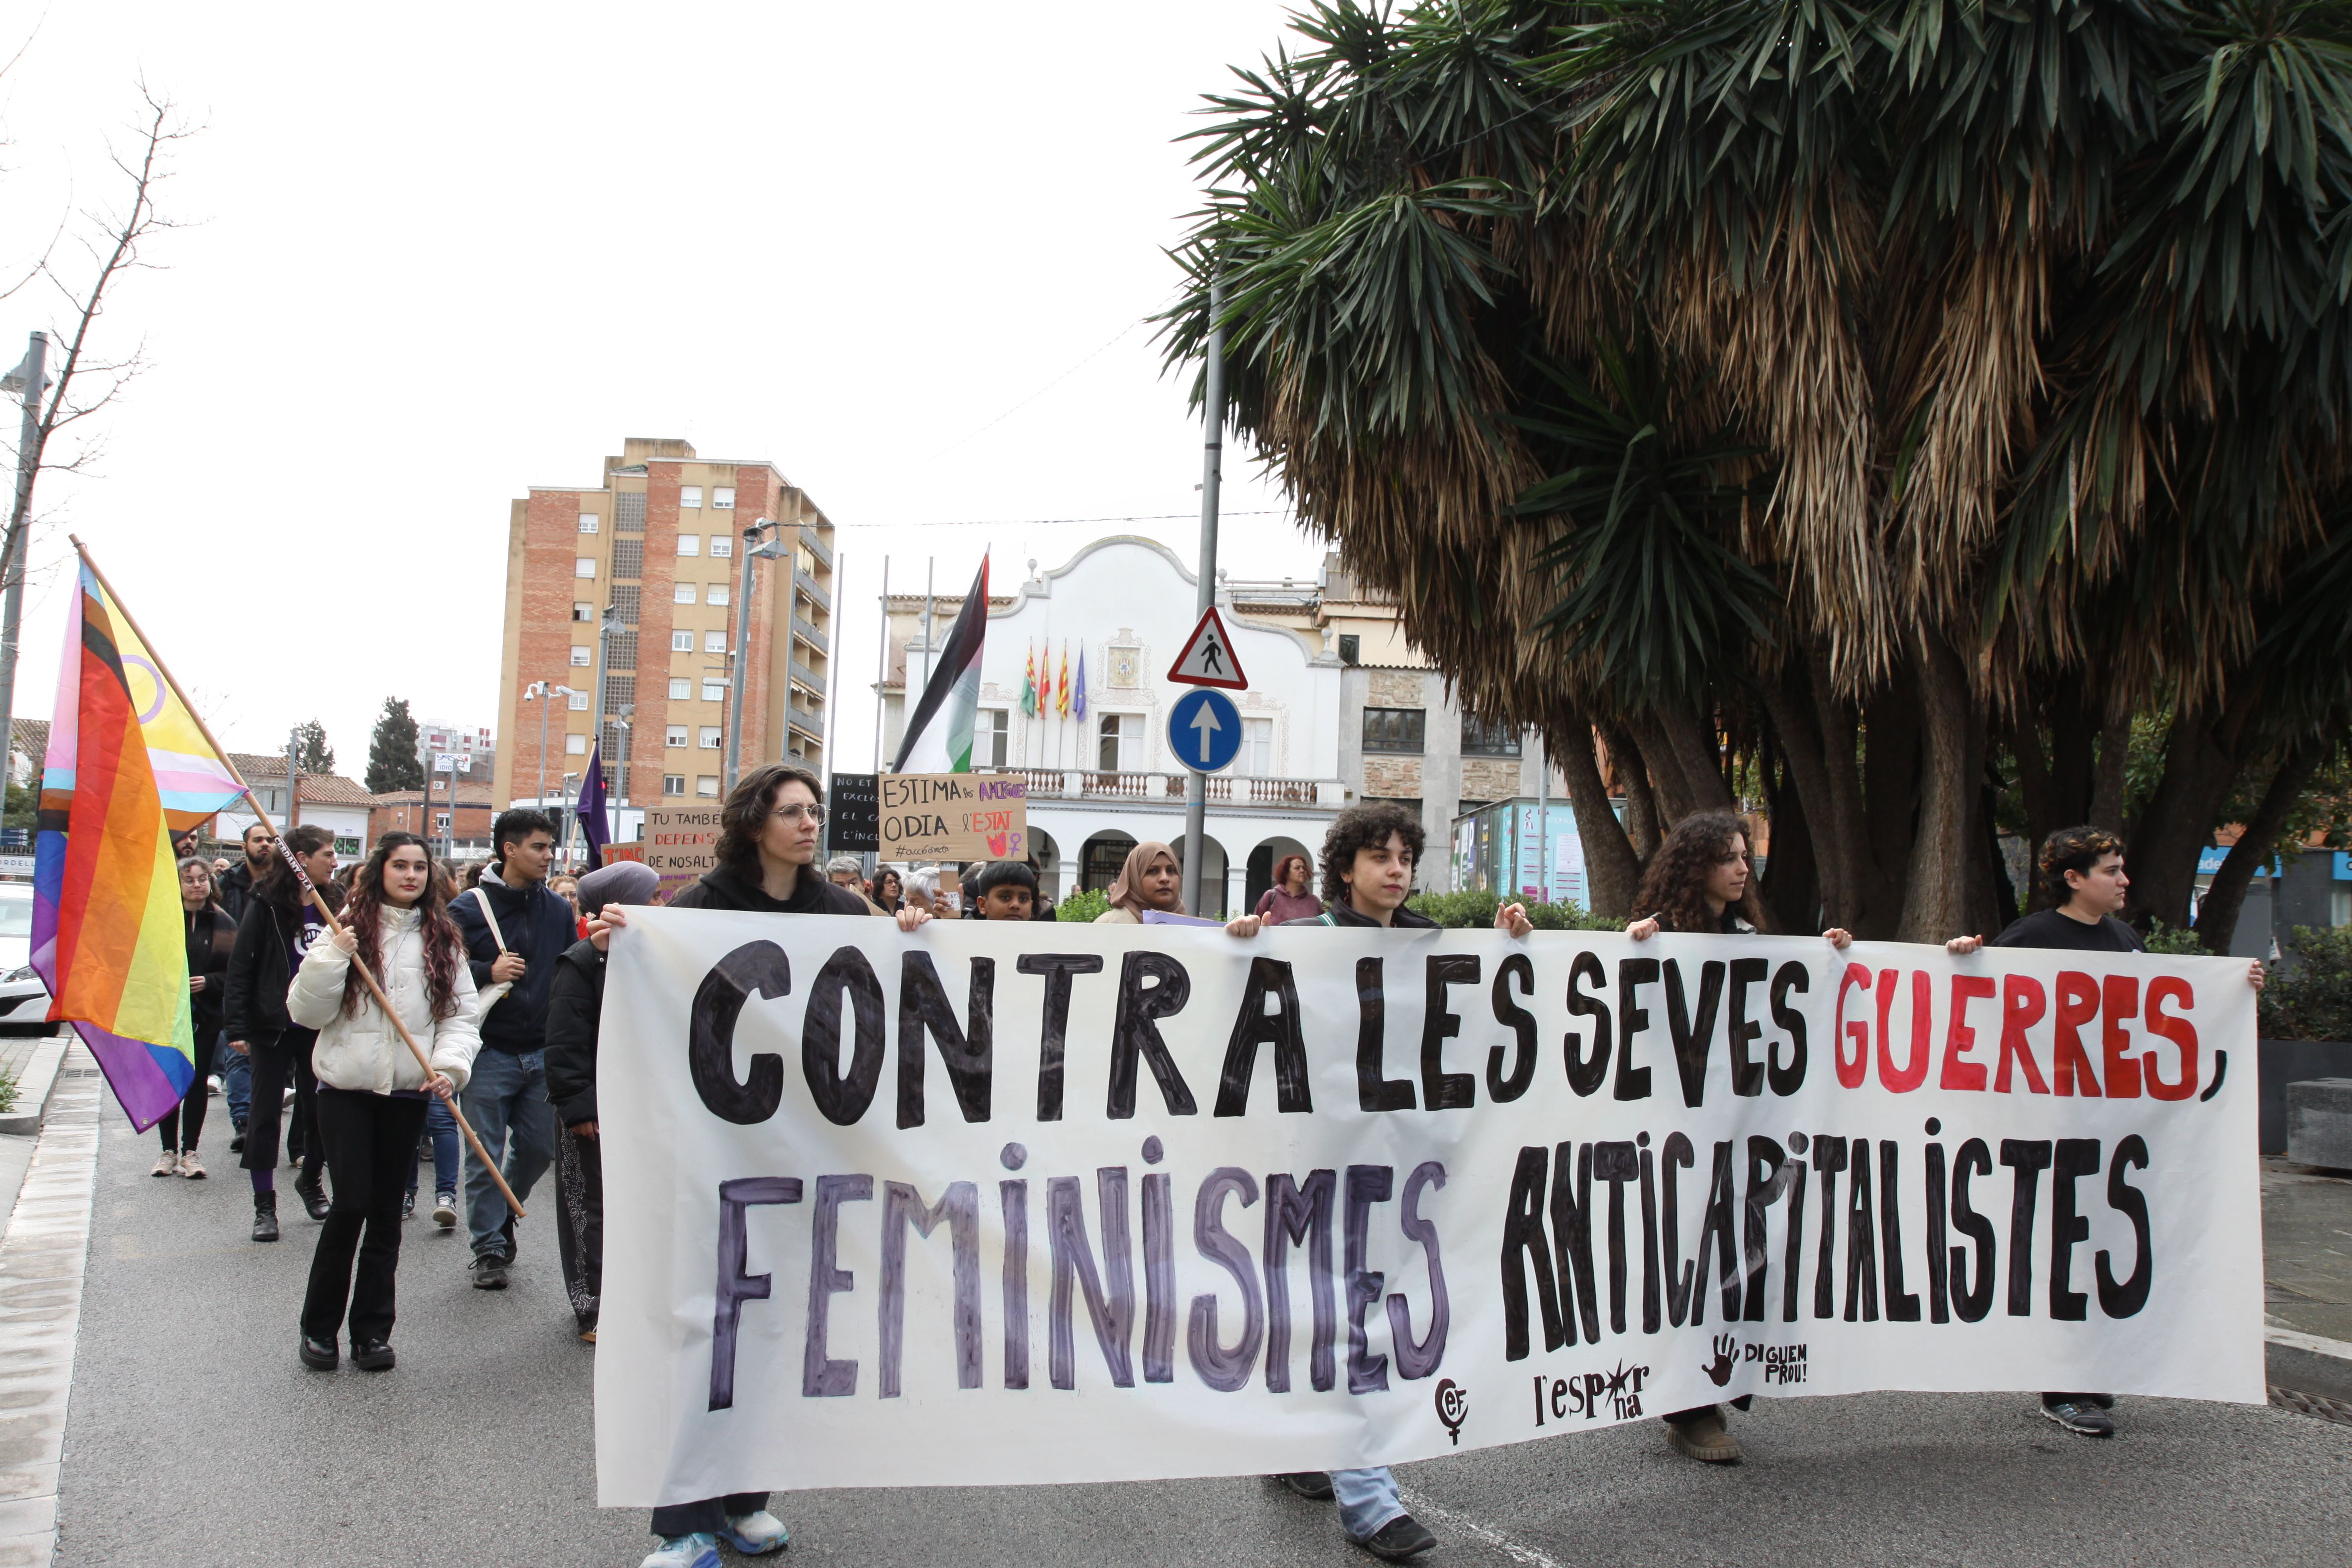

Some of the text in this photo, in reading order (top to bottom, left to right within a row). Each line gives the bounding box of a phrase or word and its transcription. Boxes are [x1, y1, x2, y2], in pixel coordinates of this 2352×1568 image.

[837, 777, 872, 787] NO ET
[883, 779, 1026, 808] ESTIMA les AMIGUES
[651, 810, 721, 825] TU TAMBÉ
[884, 810, 1013, 841] ODIA l'ESTAT
[655, 833, 716, 845] DEPENS
[603, 847, 644, 865] T'INC
[649, 855, 664, 868] DE
[688, 939, 2227, 1129] CONTRA LES SEVES GUERRES,
[1745, 1343, 1807, 1364] DIGUEM
[1765, 1364, 1807, 1385] PROU!
